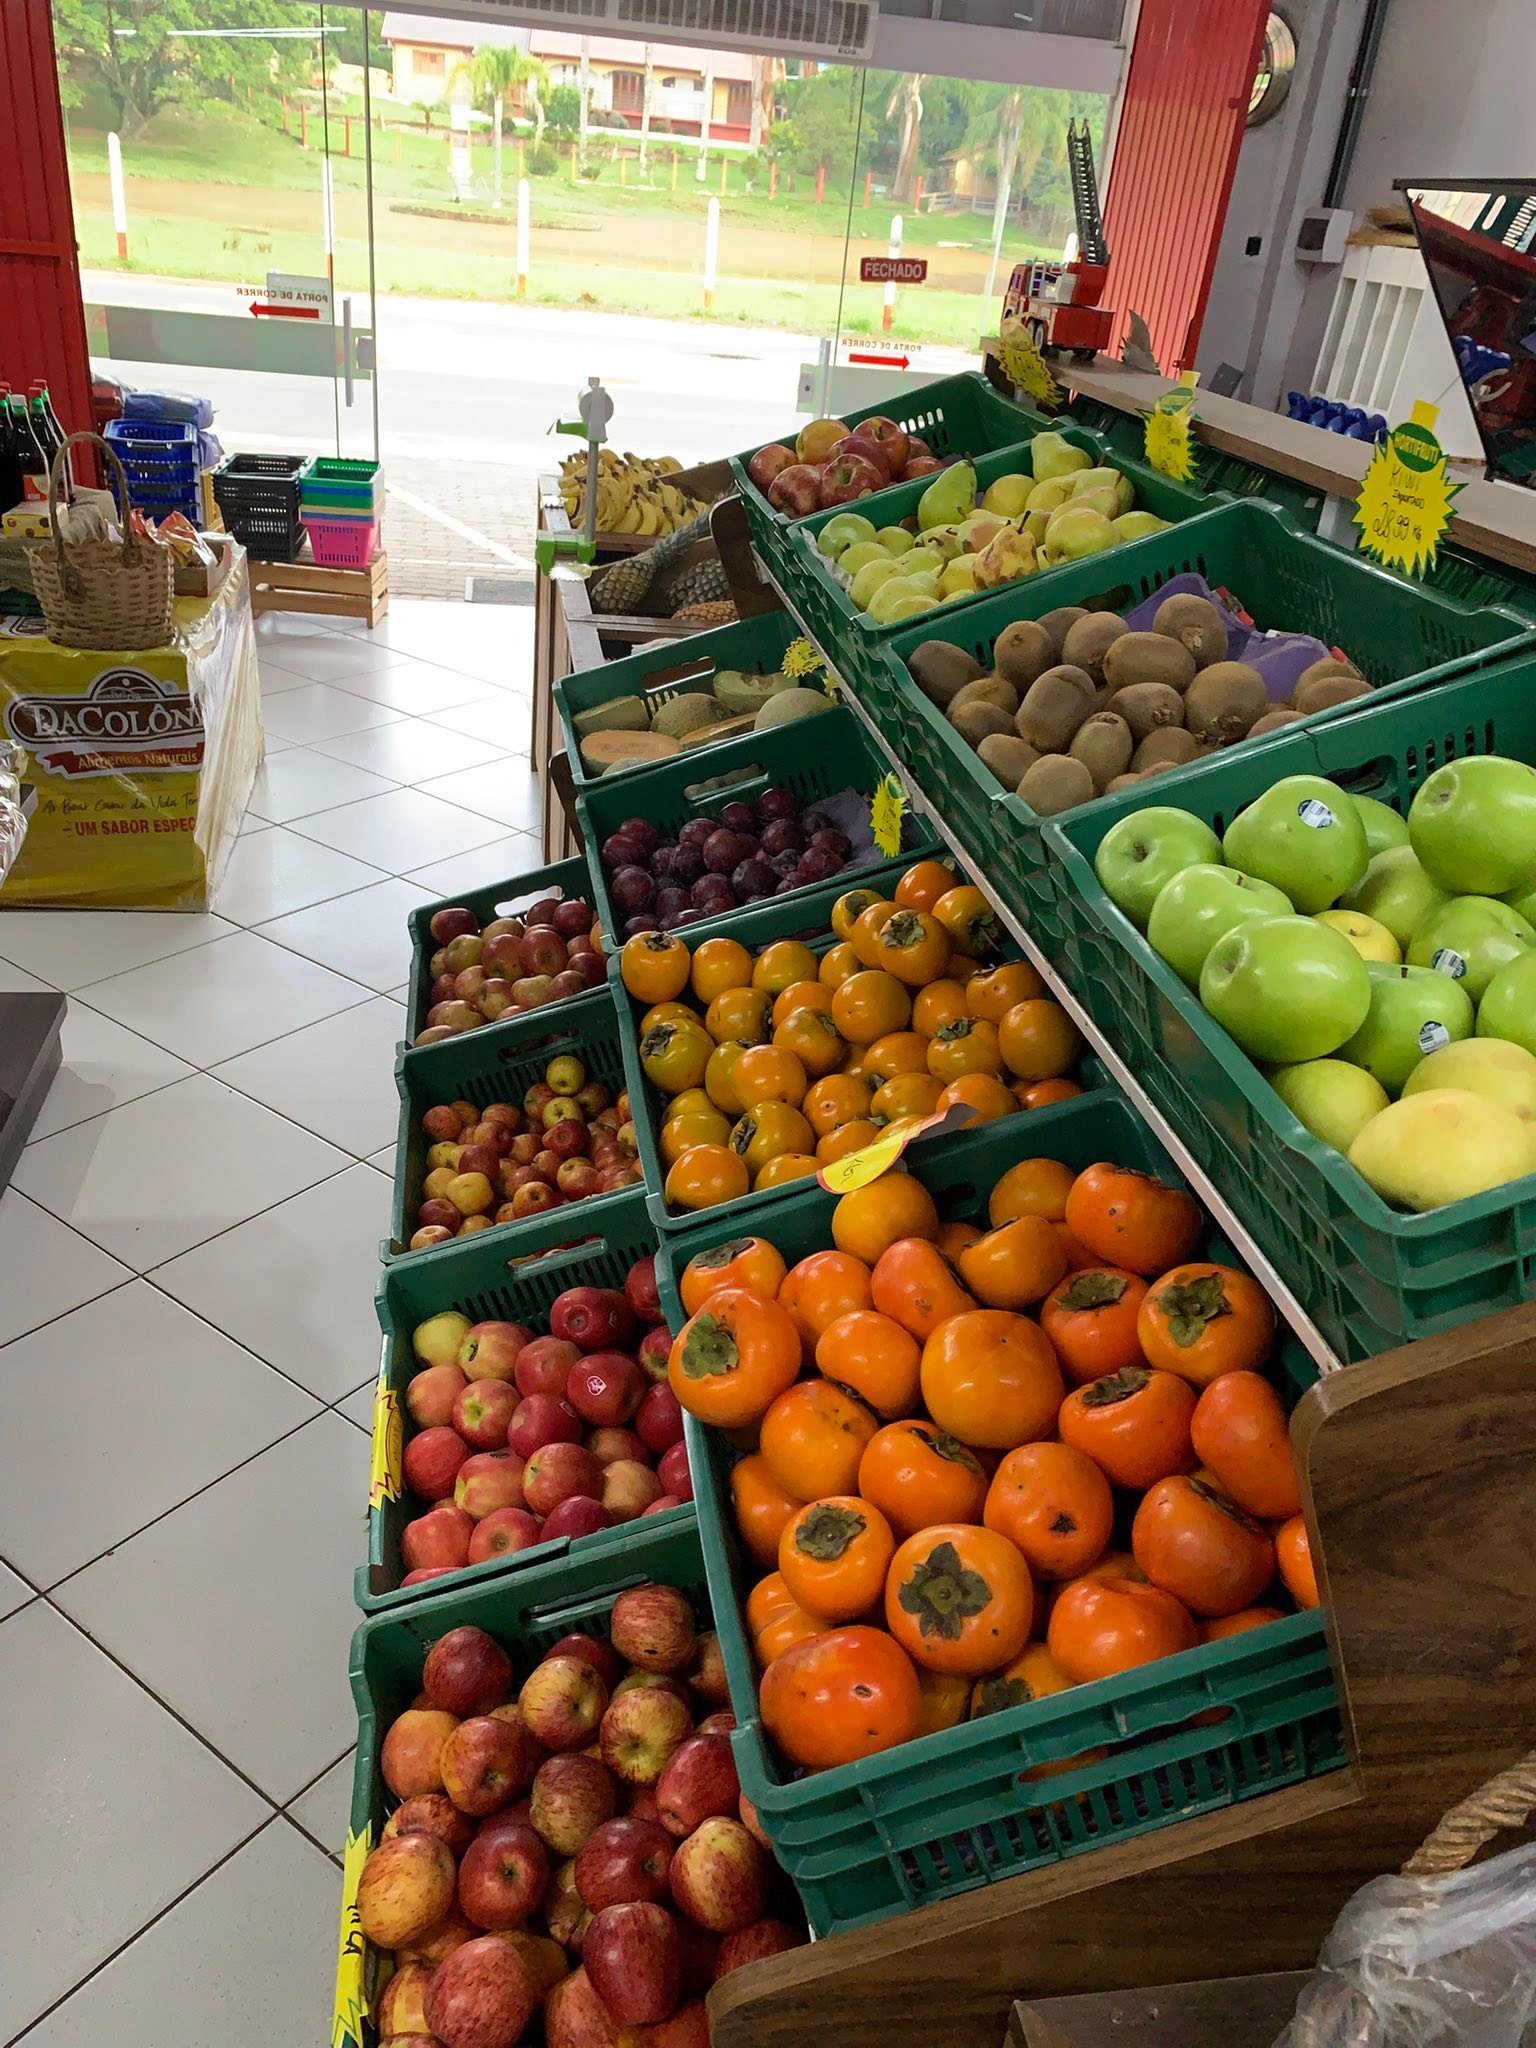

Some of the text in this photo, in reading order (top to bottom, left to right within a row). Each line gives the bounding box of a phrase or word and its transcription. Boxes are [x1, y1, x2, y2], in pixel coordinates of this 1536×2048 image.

[865, 263, 921, 278] FECHADO
[78, 752, 198, 769] Alimentos Naturais
[75, 820, 97, 836] UM
[101, 819, 149, 835] SABOR
